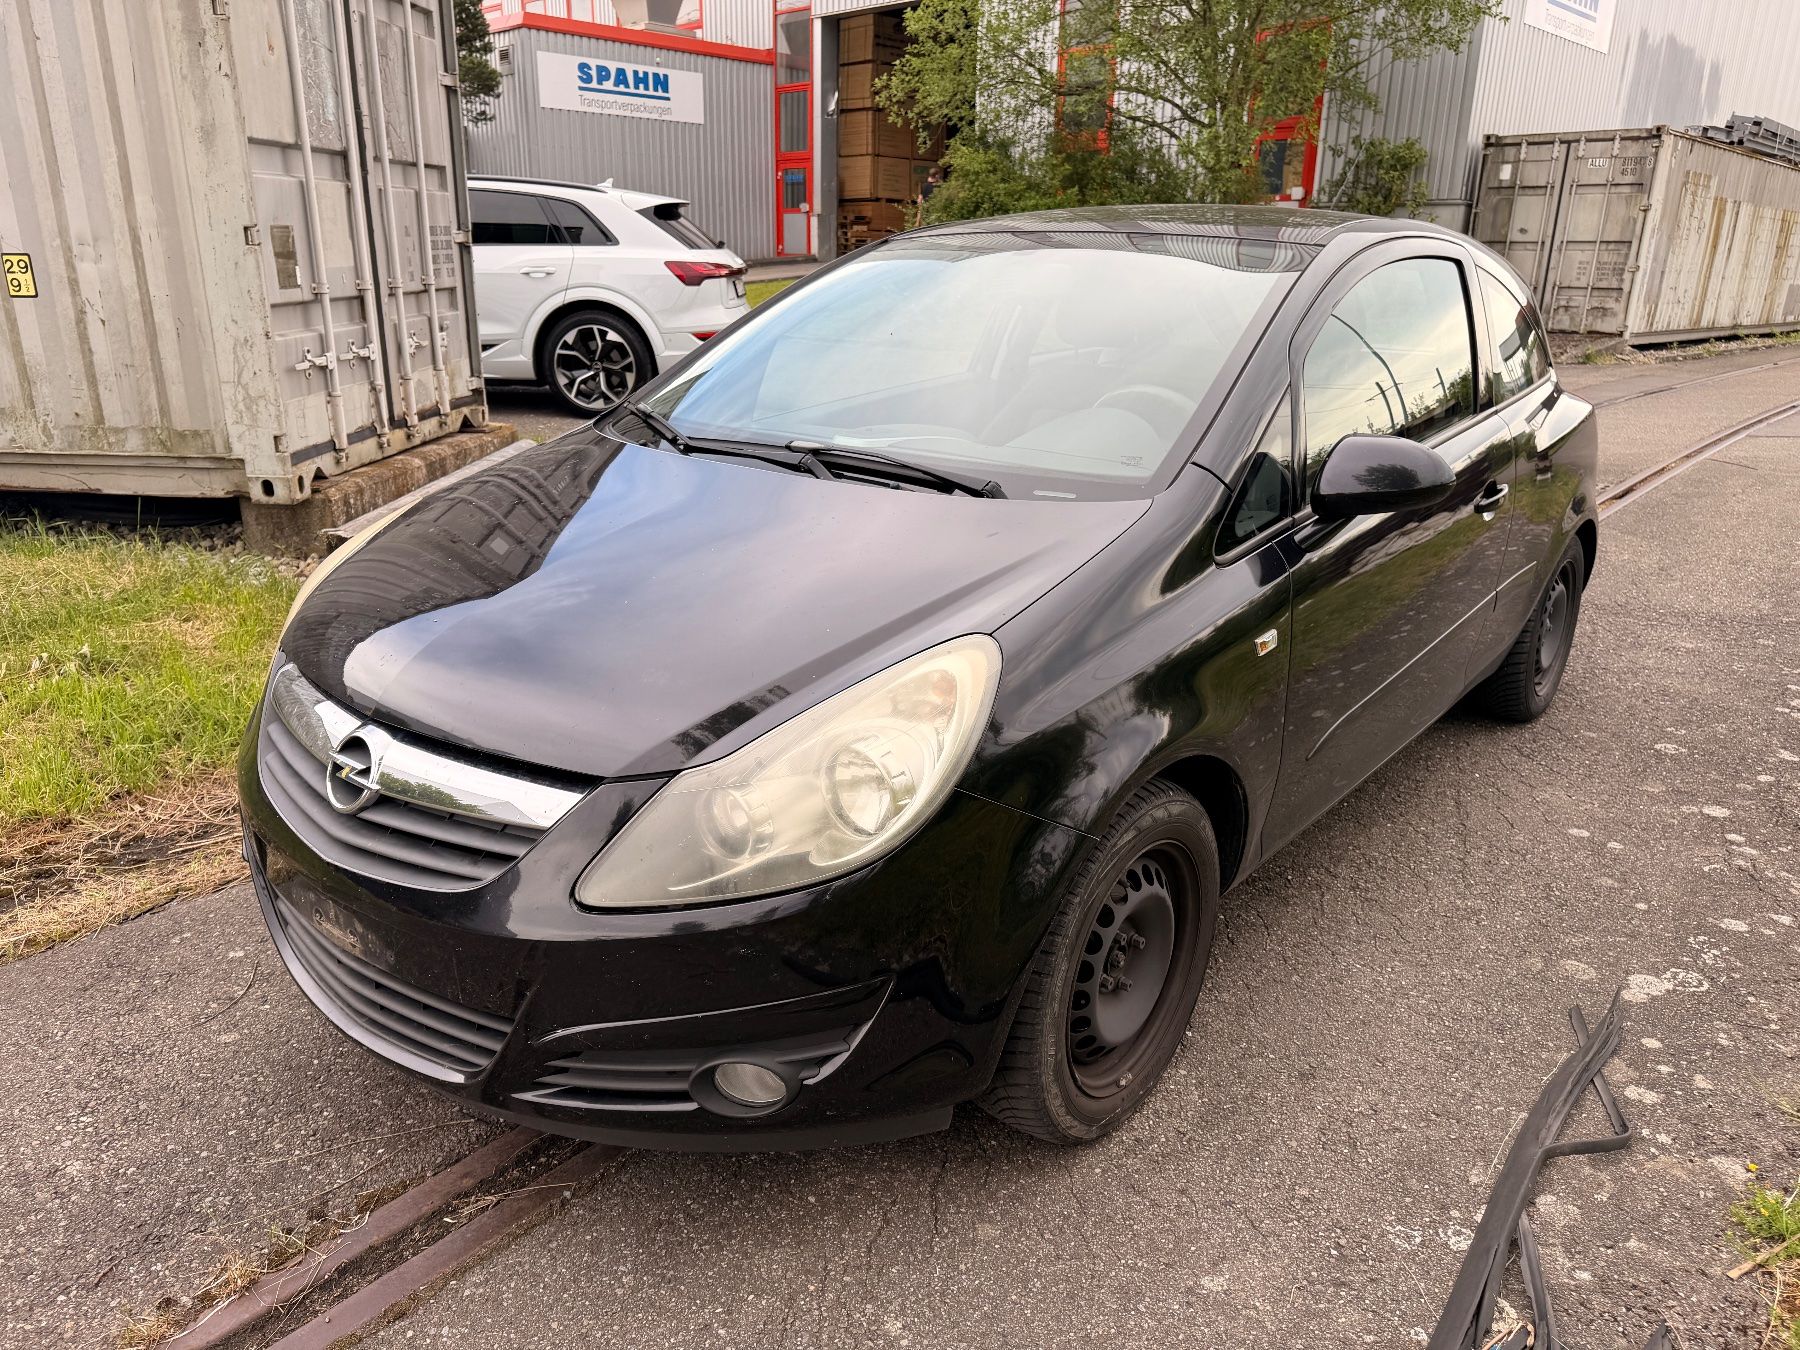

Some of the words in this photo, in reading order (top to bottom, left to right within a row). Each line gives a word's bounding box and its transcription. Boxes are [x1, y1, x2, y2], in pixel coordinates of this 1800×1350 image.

[577, 62, 669, 94] SPAHN
[578, 95, 672, 118] Transportverpackungen
[4, 258, 29, 275] 2.9
